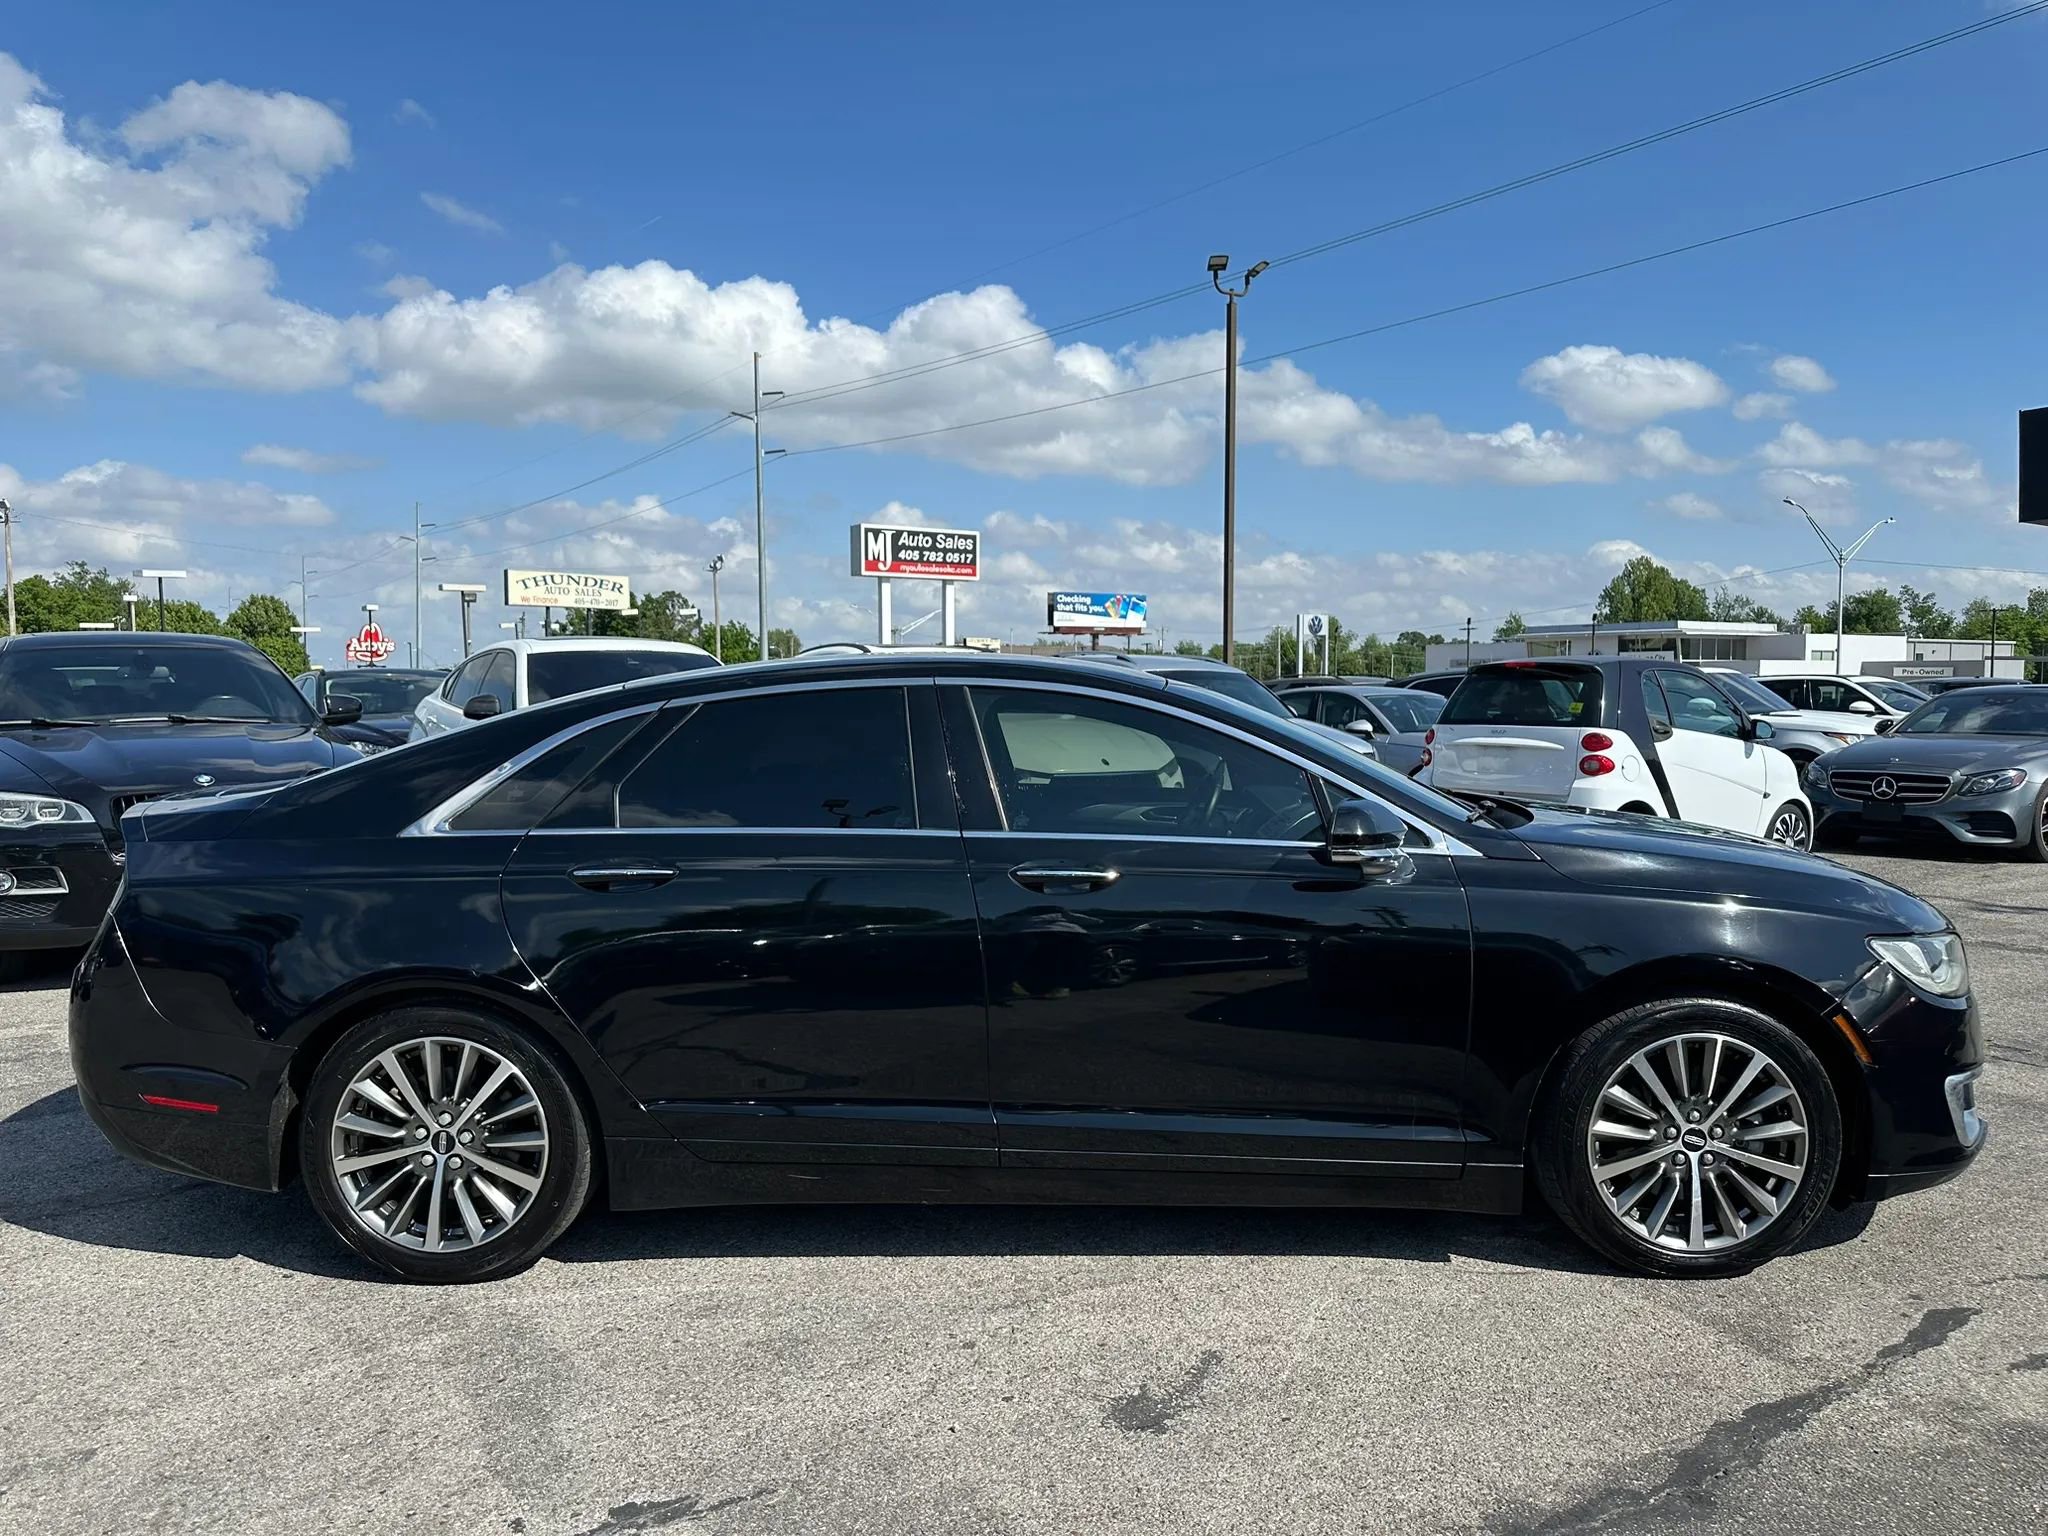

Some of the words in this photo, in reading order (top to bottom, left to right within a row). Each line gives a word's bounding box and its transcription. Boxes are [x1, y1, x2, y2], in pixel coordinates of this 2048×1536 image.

[898, 531, 932, 548] Auto
[936, 534, 974, 550] Sales
[867, 530, 896, 571] MJ
[898, 550, 919, 560] 405
[923, 551, 943, 562] 782
[946, 554, 973, 564] 0517
[516, 574, 624, 595] THUNDER
[544, 587, 570, 596] AUTO
[575, 588, 602, 596] SALES
[1057, 595, 1091, 604] Checking
[1056, 603, 1074, 611] that
[1075, 603, 1088, 612] fits
[1089, 605, 1105, 613] you.
[349, 638, 395, 655] Arby's
